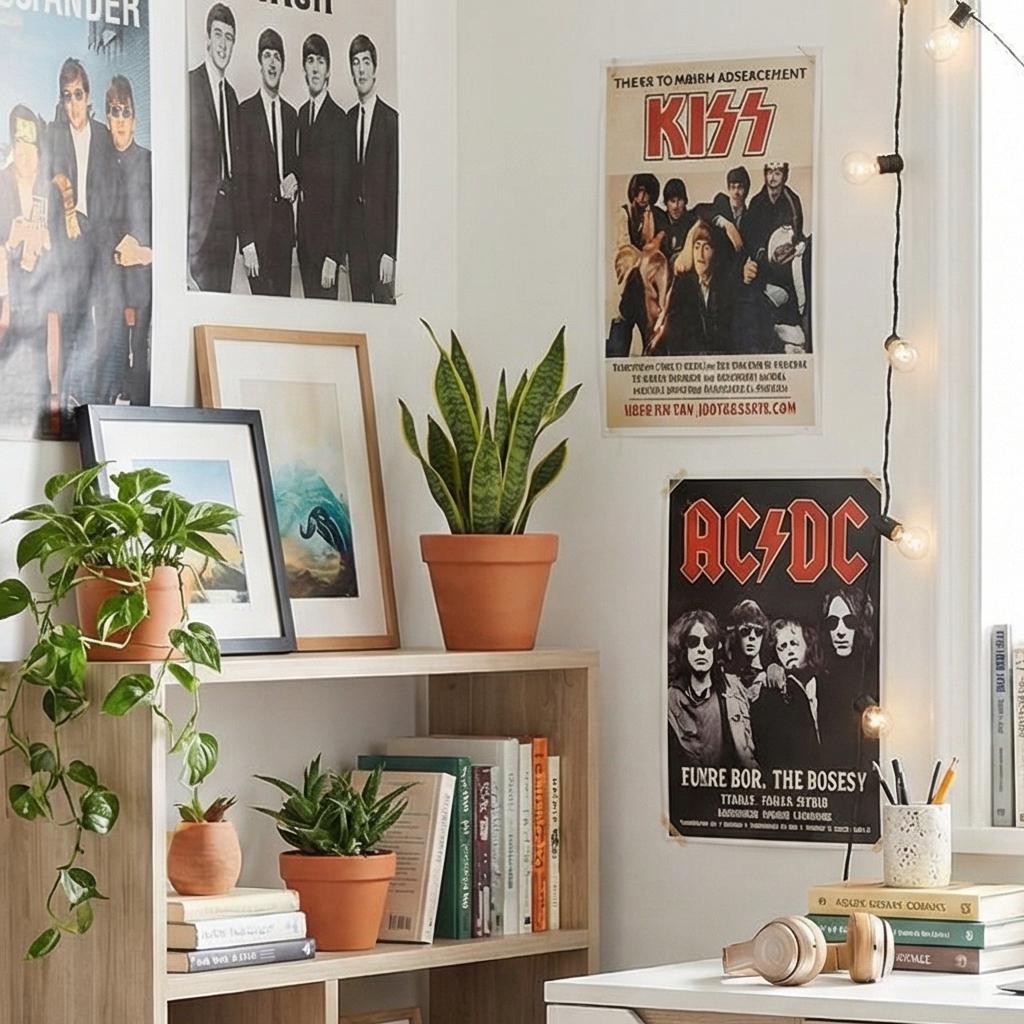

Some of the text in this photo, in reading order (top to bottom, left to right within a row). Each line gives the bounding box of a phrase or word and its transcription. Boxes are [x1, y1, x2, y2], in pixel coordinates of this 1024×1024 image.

[656, 75, 673, 87] TO
[644, 87, 777, 161] KISS
[772, 769, 804, 790] THE
[807, 770, 867, 792] BOSESY
